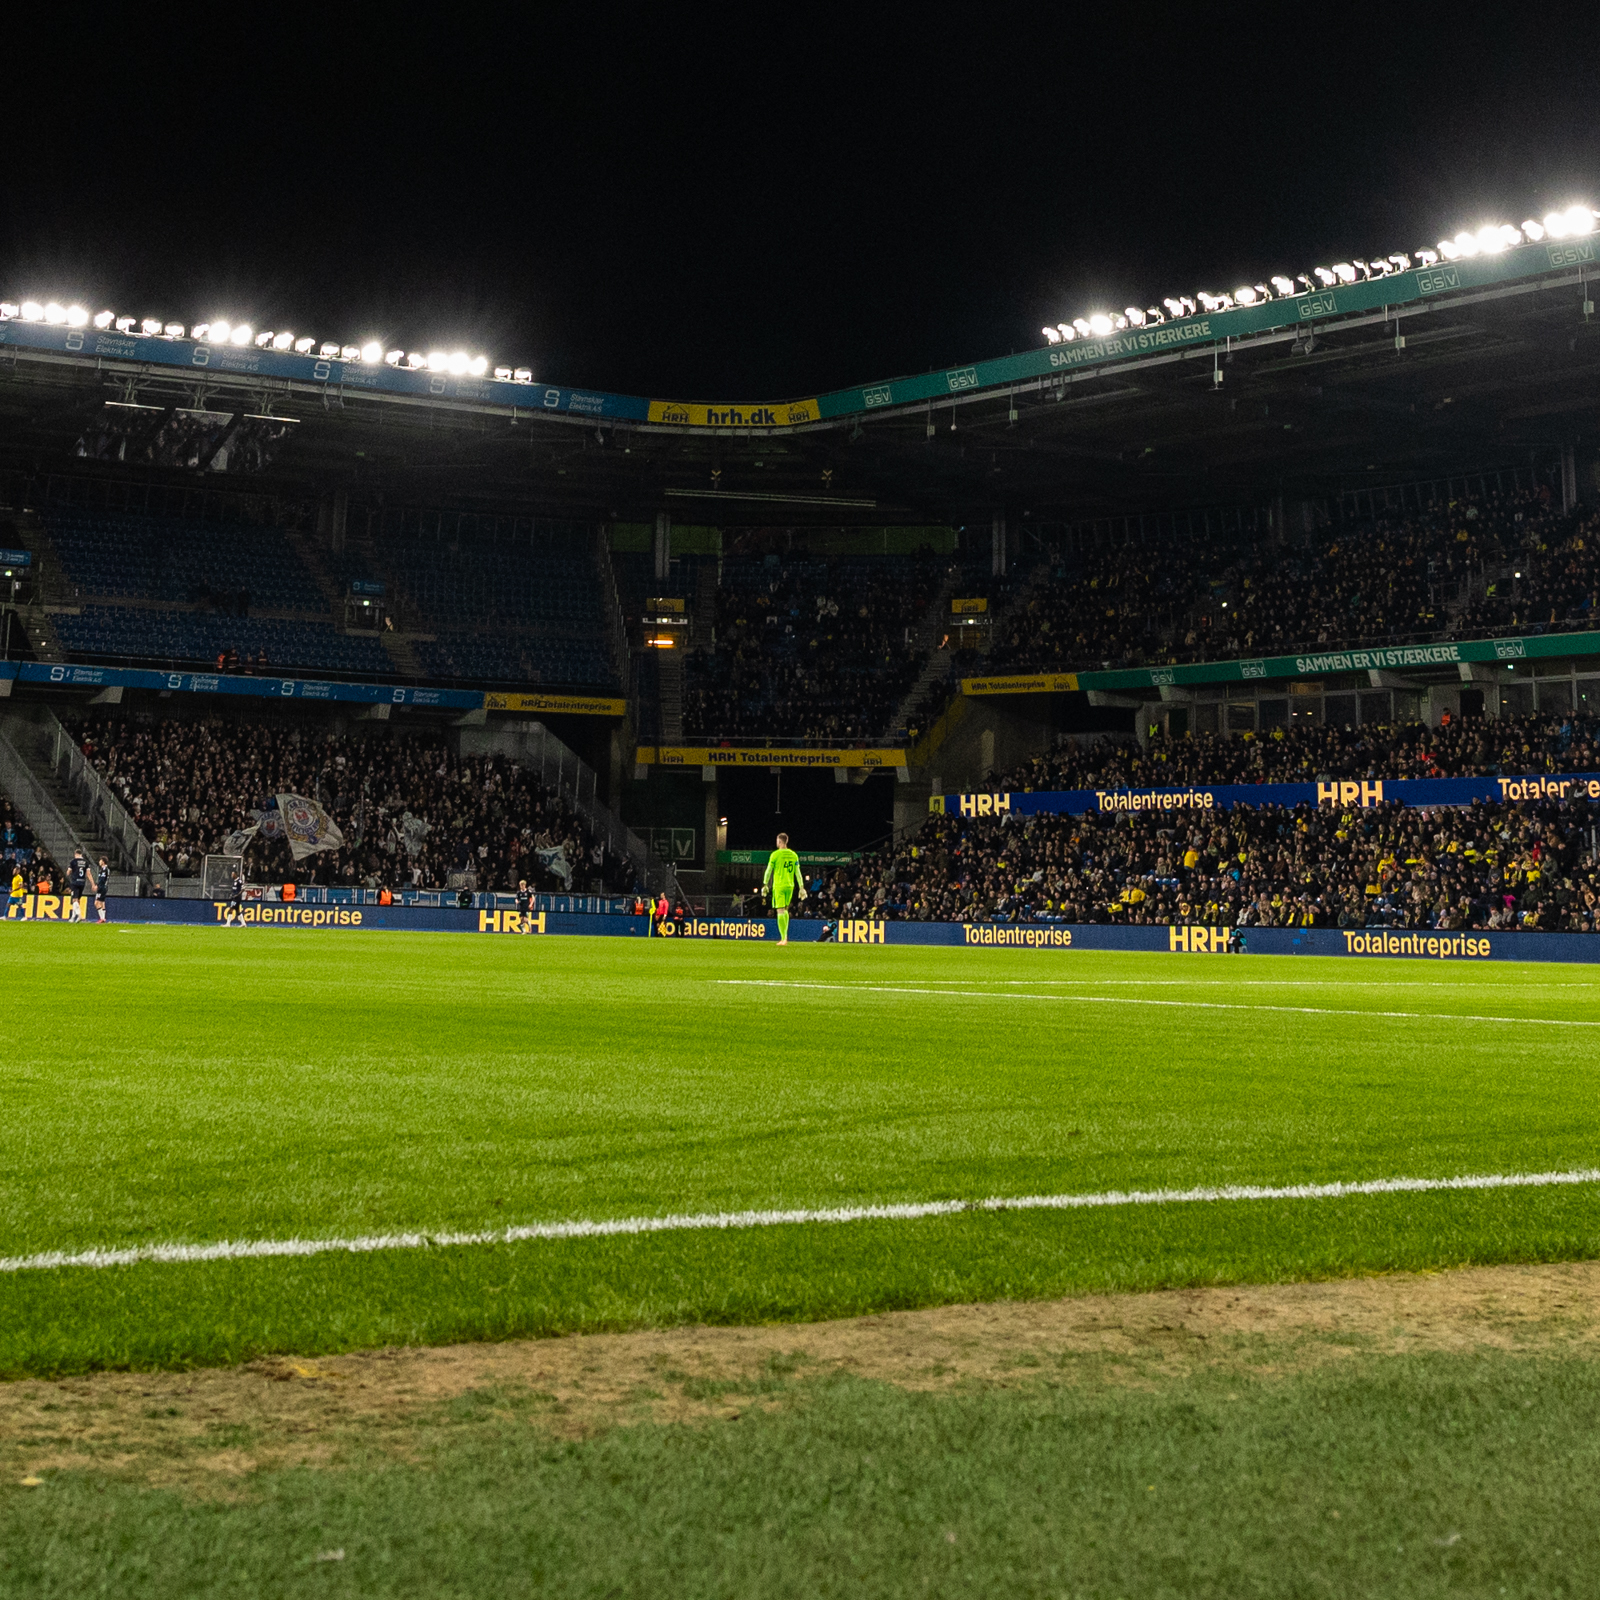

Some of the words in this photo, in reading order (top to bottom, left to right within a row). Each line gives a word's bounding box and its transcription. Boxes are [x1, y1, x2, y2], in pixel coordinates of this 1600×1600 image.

[1550, 246, 1592, 266] GSV
[1419, 272, 1458, 293] GSV
[1300, 298, 1335, 317] GSV
[1049, 343, 1104, 368] SAMMEN
[1105, 339, 1123, 357] ER
[1123, 336, 1138, 353] VI
[1138, 320, 1211, 349] STÆRKERE
[949, 372, 977, 389] GSV
[864, 390, 891, 407] GSV
[662, 412, 690, 424] HRH
[706, 407, 776, 426] hrh.dk
[788, 410, 811, 423] HRH
[1296, 655, 1350, 673] SAMMEN
[1352, 653, 1370, 669] ER
[1371, 651, 1386, 667] VI
[1386, 645, 1462, 666] STÆRKERE
[1496, 643, 1524, 658] GSV
[1151, 671, 1174, 684] GSV
[1241, 664, 1265, 678] GSV
[663, 756, 684, 764] HRH
[708, 752, 737, 763] HRH
[740, 752, 841, 766] Totalentreprise
[863, 758, 883, 766] HRH
[1096, 788, 1213, 811] Totalentreprise
[1317, 781, 1383, 808] HRH
[960, 792, 1010, 817] HRH
[732, 853, 751, 862] GSV
[783, 860, 794, 874] 45
[8, 894, 88, 920] HRH
[213, 901, 363, 927] Toalentreprise
[478, 909, 546, 934] HRH
[837, 919, 885, 943] HRH
[963, 923, 1072, 948] Totalentreprise
[1169, 925, 1229, 953] HRH
[1343, 930, 1491, 959] Totalentreprise
